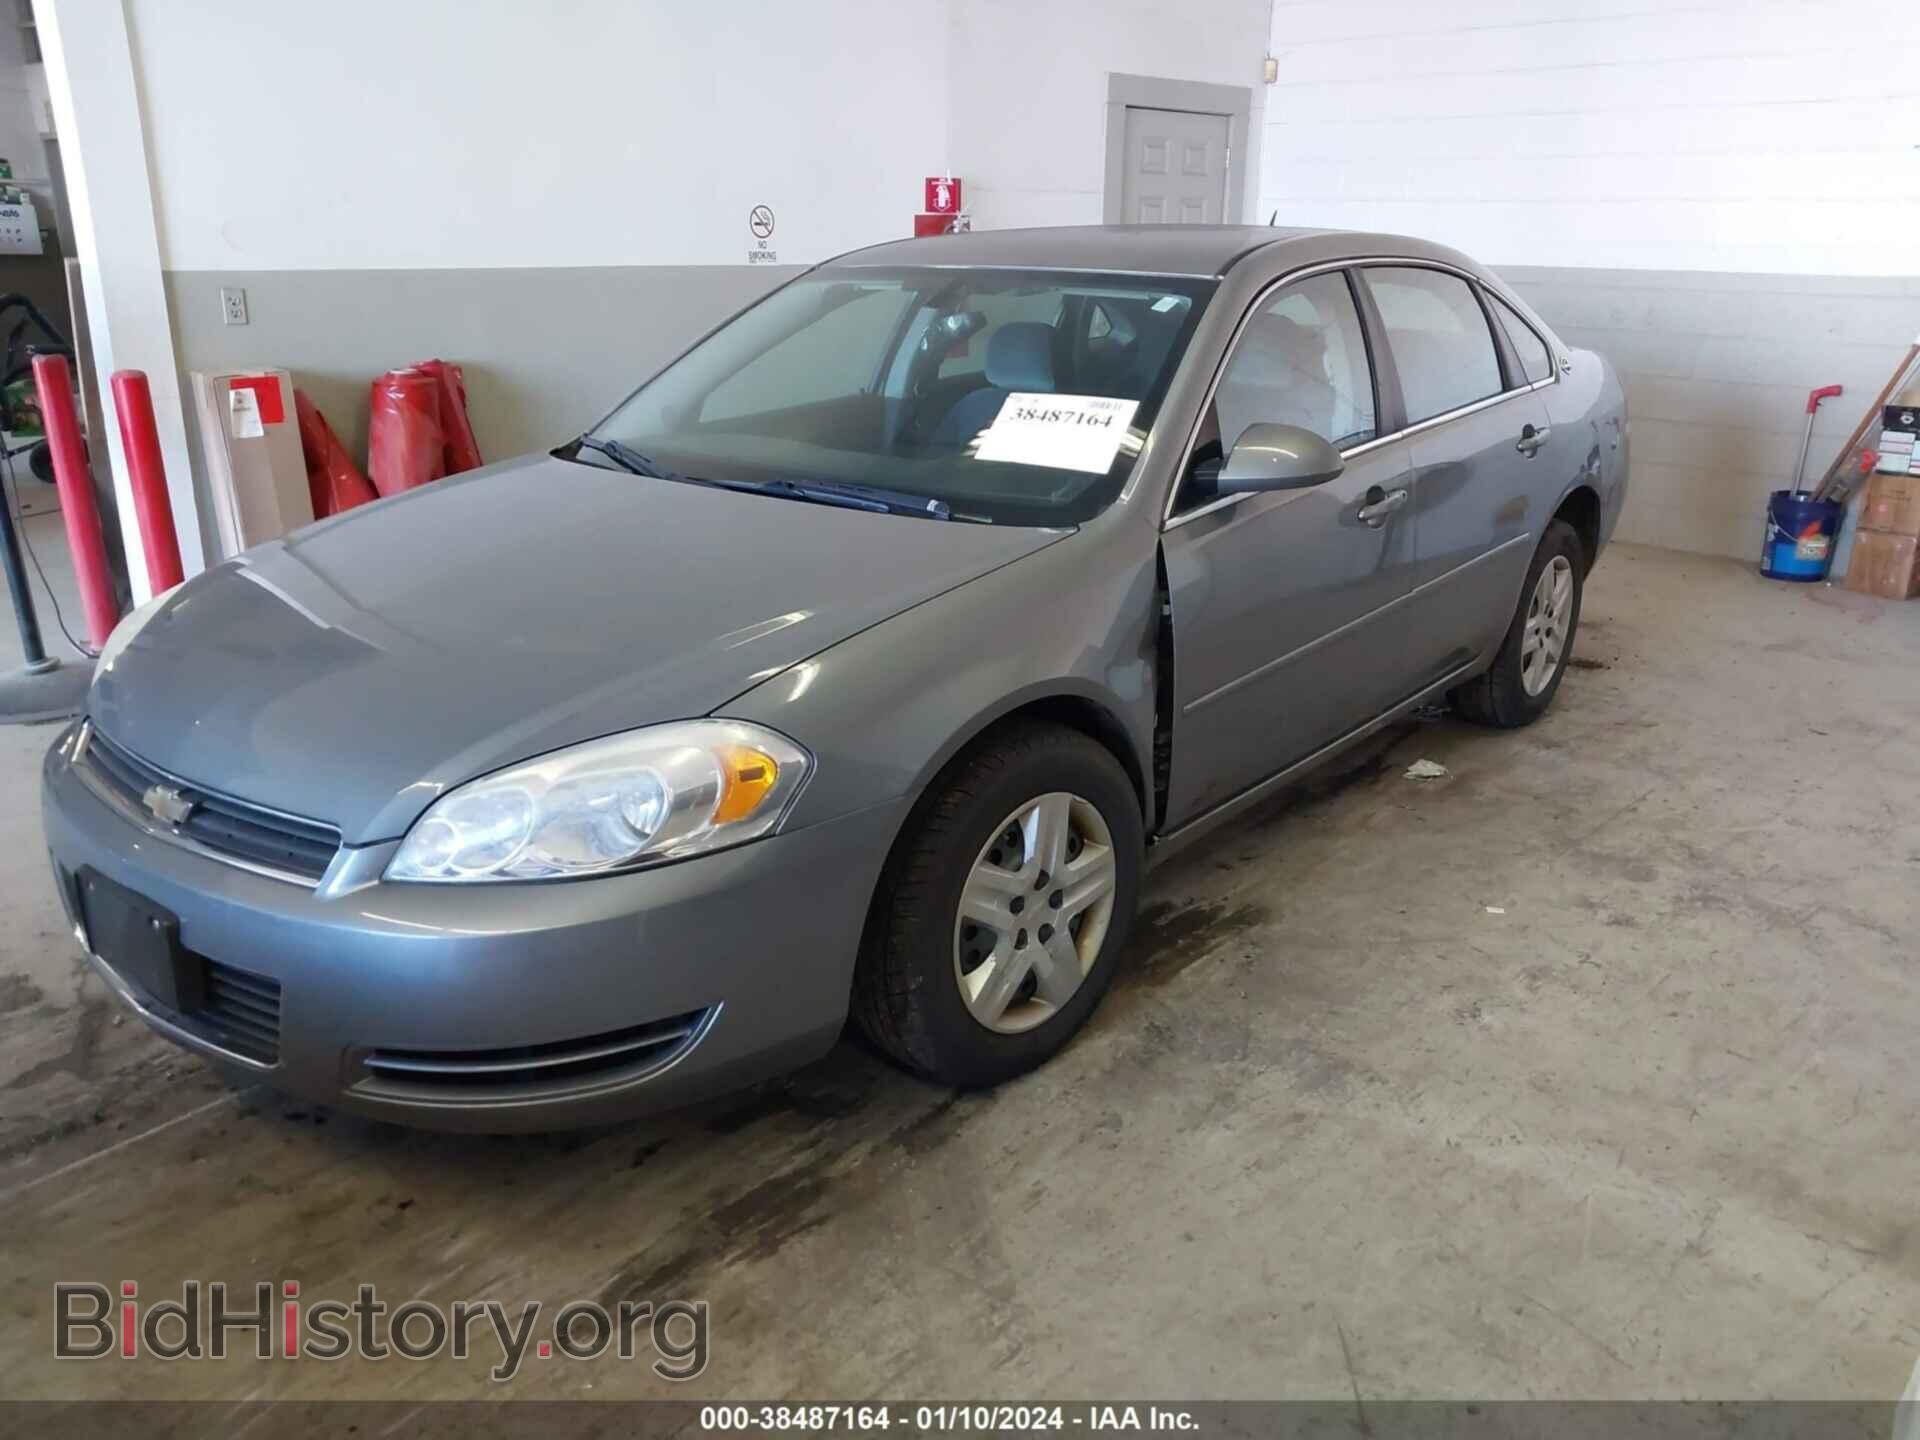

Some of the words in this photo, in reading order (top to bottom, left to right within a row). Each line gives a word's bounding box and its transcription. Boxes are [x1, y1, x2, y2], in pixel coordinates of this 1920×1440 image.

[757, 240, 768, 249] NO
[748, 251, 777, 260] SMOKING
[1009, 407, 1114, 428] 38487164
